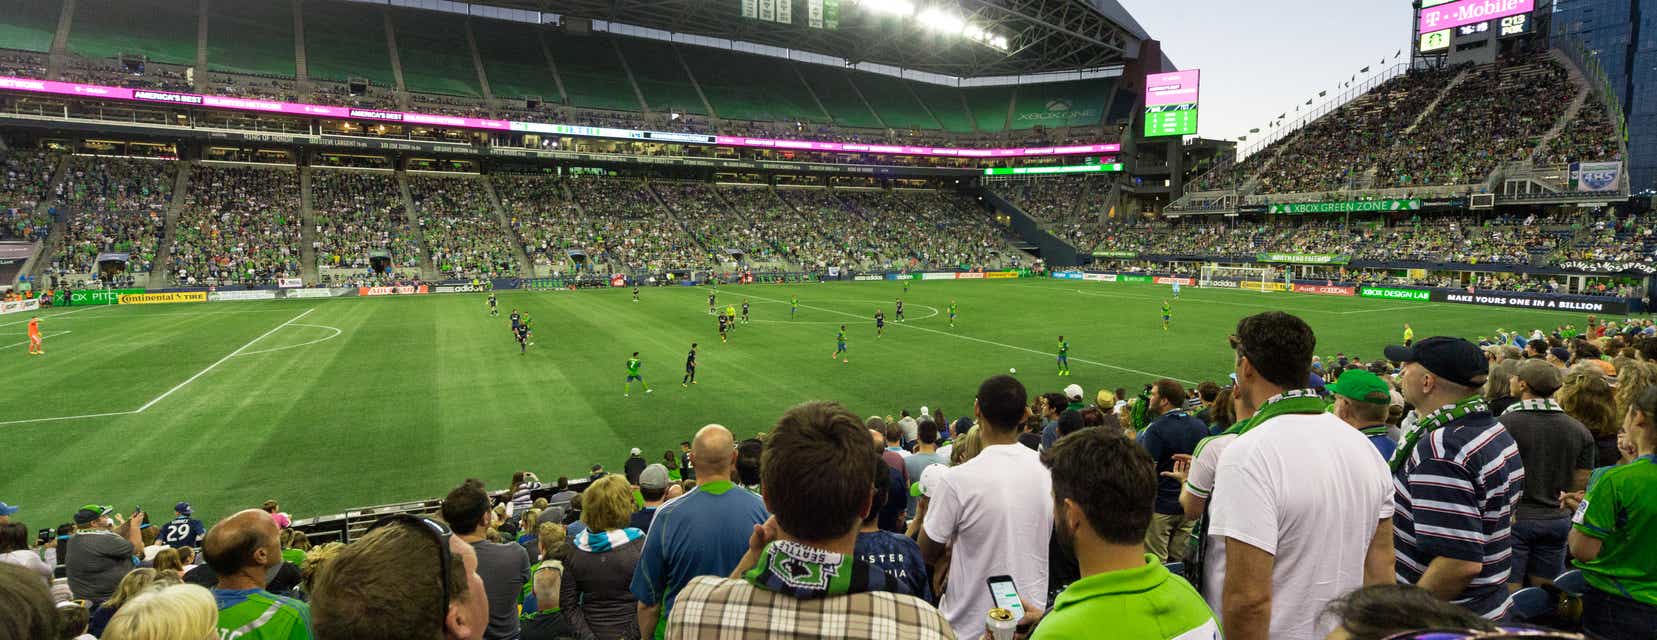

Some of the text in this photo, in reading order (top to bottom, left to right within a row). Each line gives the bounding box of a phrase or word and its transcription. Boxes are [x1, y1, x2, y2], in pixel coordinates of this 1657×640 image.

[1501, 14, 1526, 27] Q13
[135, 91, 202, 104] AMERICA'S BEST
[351, 110, 385, 118] AMERICA'S
[1017, 111, 1096, 121] XBOX ONE
[1294, 201, 1387, 213] XBOX GREEN ZONE
[56, 294, 87, 302] XOX
[121, 293, 175, 303] Continental
[1364, 288, 1429, 300] XBOX DESIGN LAB
[1447, 294, 1603, 311] MAKE YOURS ONE IN A BILLION
[166, 523, 190, 543] 29
[779, 541, 825, 563] SEATTLE
